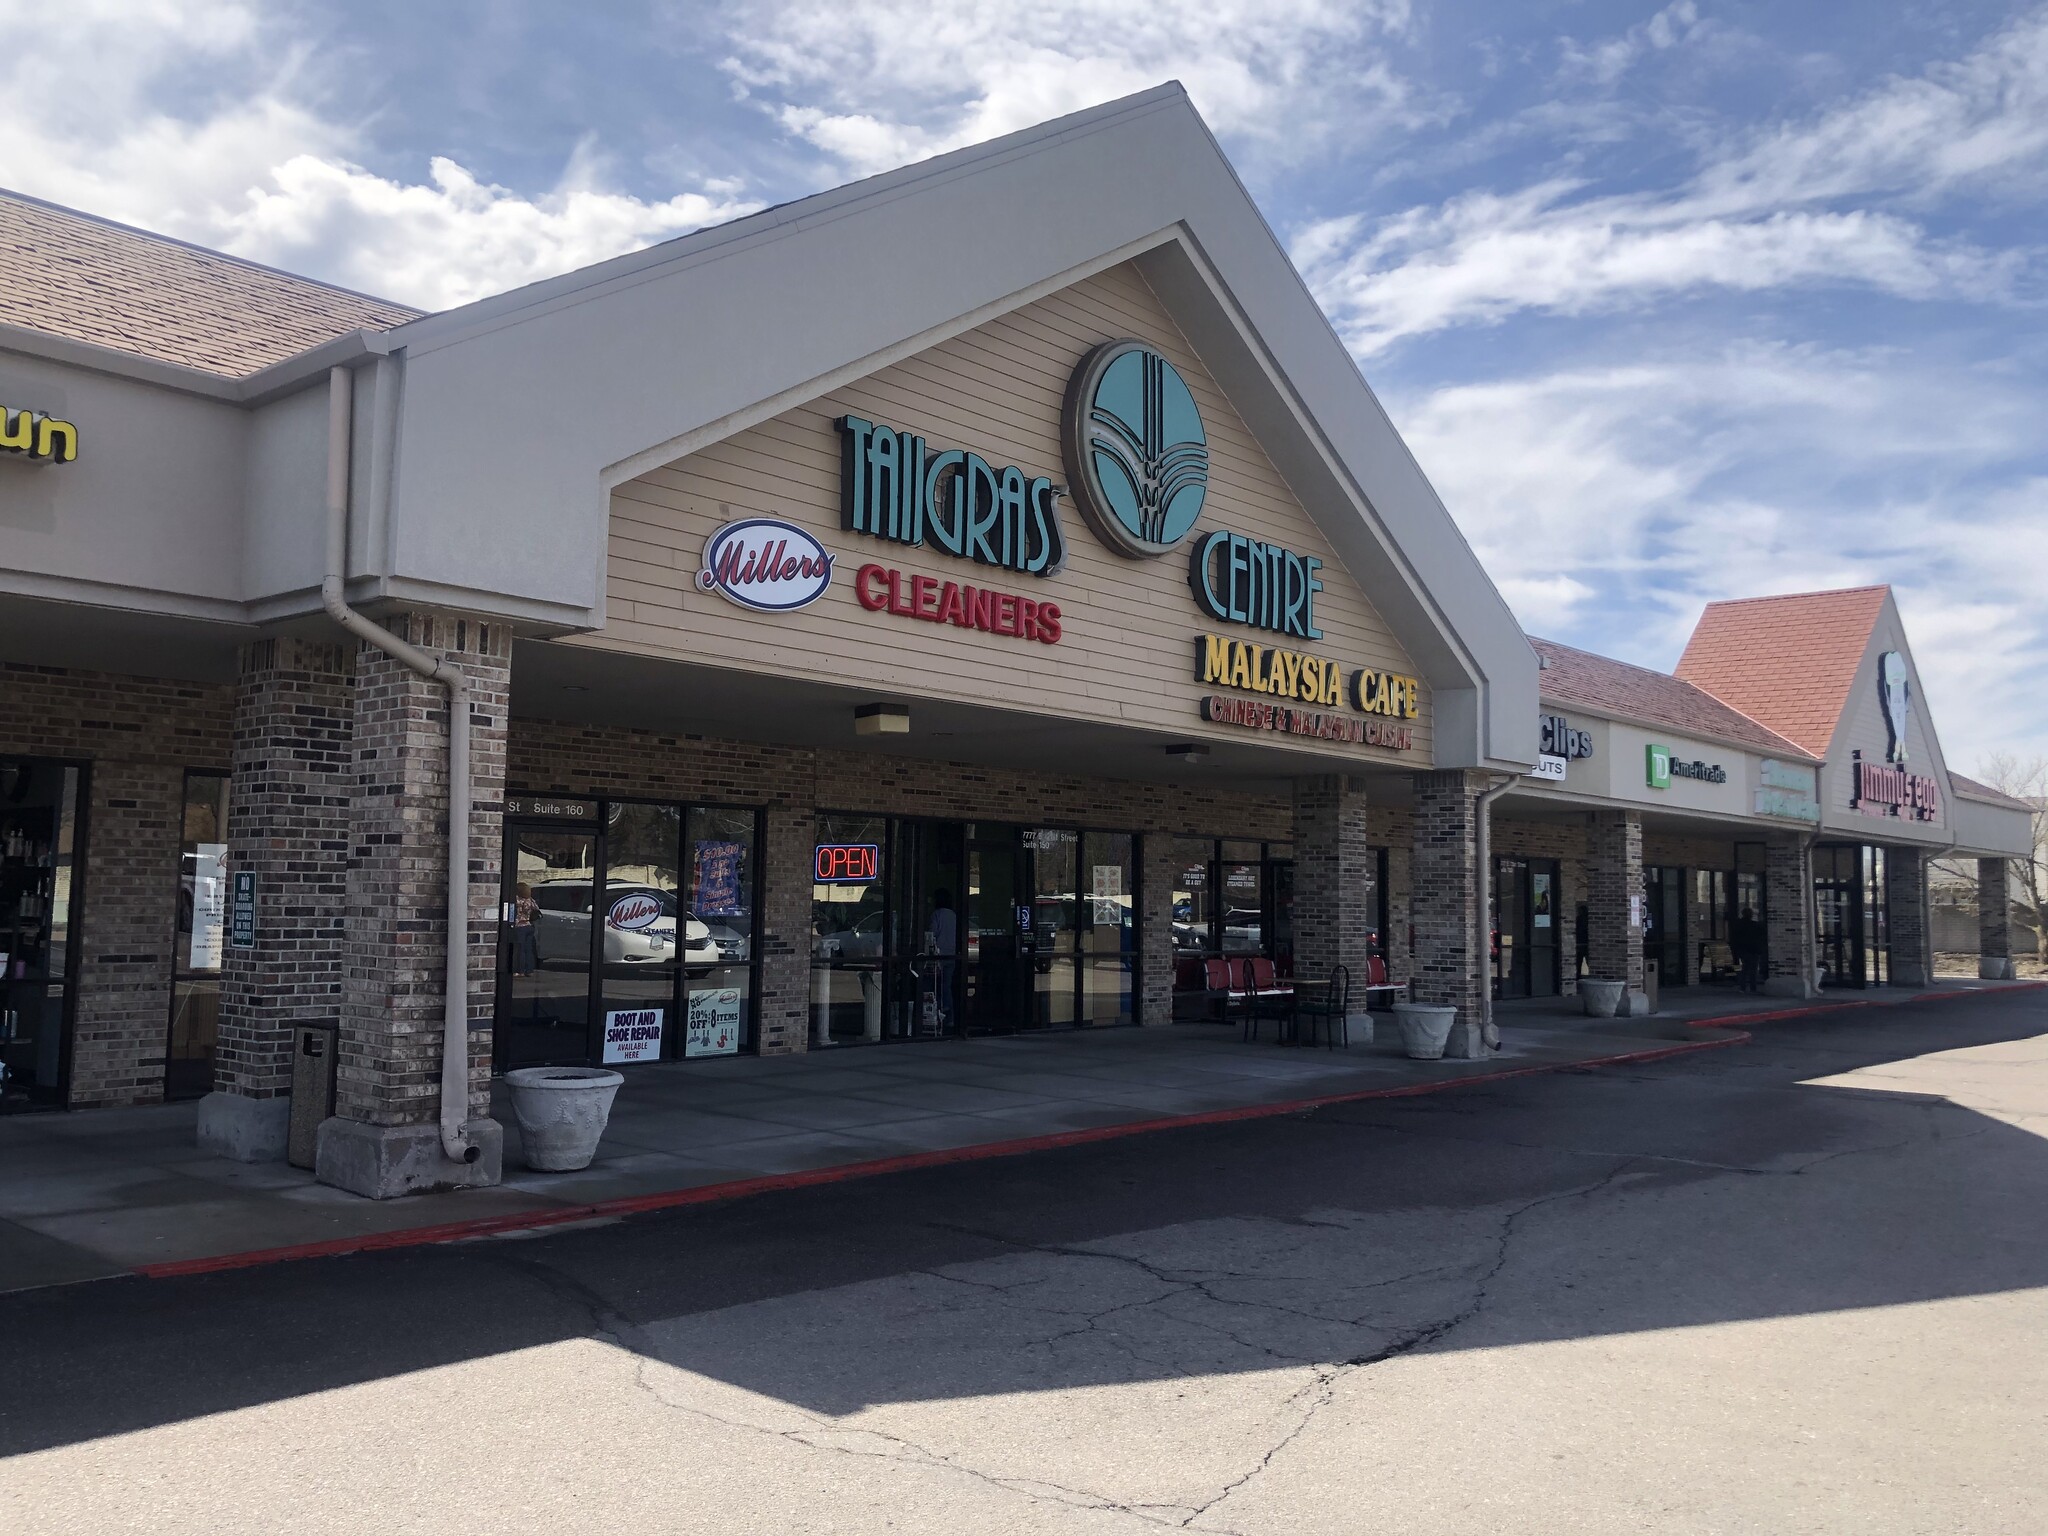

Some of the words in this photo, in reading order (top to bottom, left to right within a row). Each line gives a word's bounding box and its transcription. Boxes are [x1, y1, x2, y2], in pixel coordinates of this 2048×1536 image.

[701, 538, 835, 590] Millers
[1189, 530, 1324, 640] CENTRE
[855, 563, 1062, 644] CLEANERS
[1195, 634, 1343, 707] MALAYSIA
[1351, 668, 1418, 719] CAFE
[1201, 695, 1273, 730] CHINESE
[1275, 706, 1287, 732] &
[1289, 709, 1363, 744] MALAYSIAN
[1364, 720, 1414, 751] CUISINE
[1539, 714, 1593, 762] Clips
[1532, 759, 1563, 774] UTS
[1652, 753, 1669, 780] TD
[1669, 756, 1727, 784] Ameritrade
[508, 801, 521, 812] St
[533, 803, 561, 814] Suite
[565, 805, 584, 815] 160
[1060, 833, 1078, 842] Street
[817, 846, 876, 878] OPEN
[240, 876, 250, 891] NO
[607, 900, 664, 927] Millers
[614, 1013, 637, 1027] BOOT
[637, 1012, 656, 1026] AND
[690, 1010, 708, 1020] 20%
[717, 1013, 738, 1022] ITEMS
[690, 1019, 708, 1029] OFF
[607, 1028, 630, 1042] SHOE
[630, 1026, 660, 1041] REPAIR
[617, 1042, 648, 1051] AVAILABLE
[624, 1051, 640, 1059] HERE
